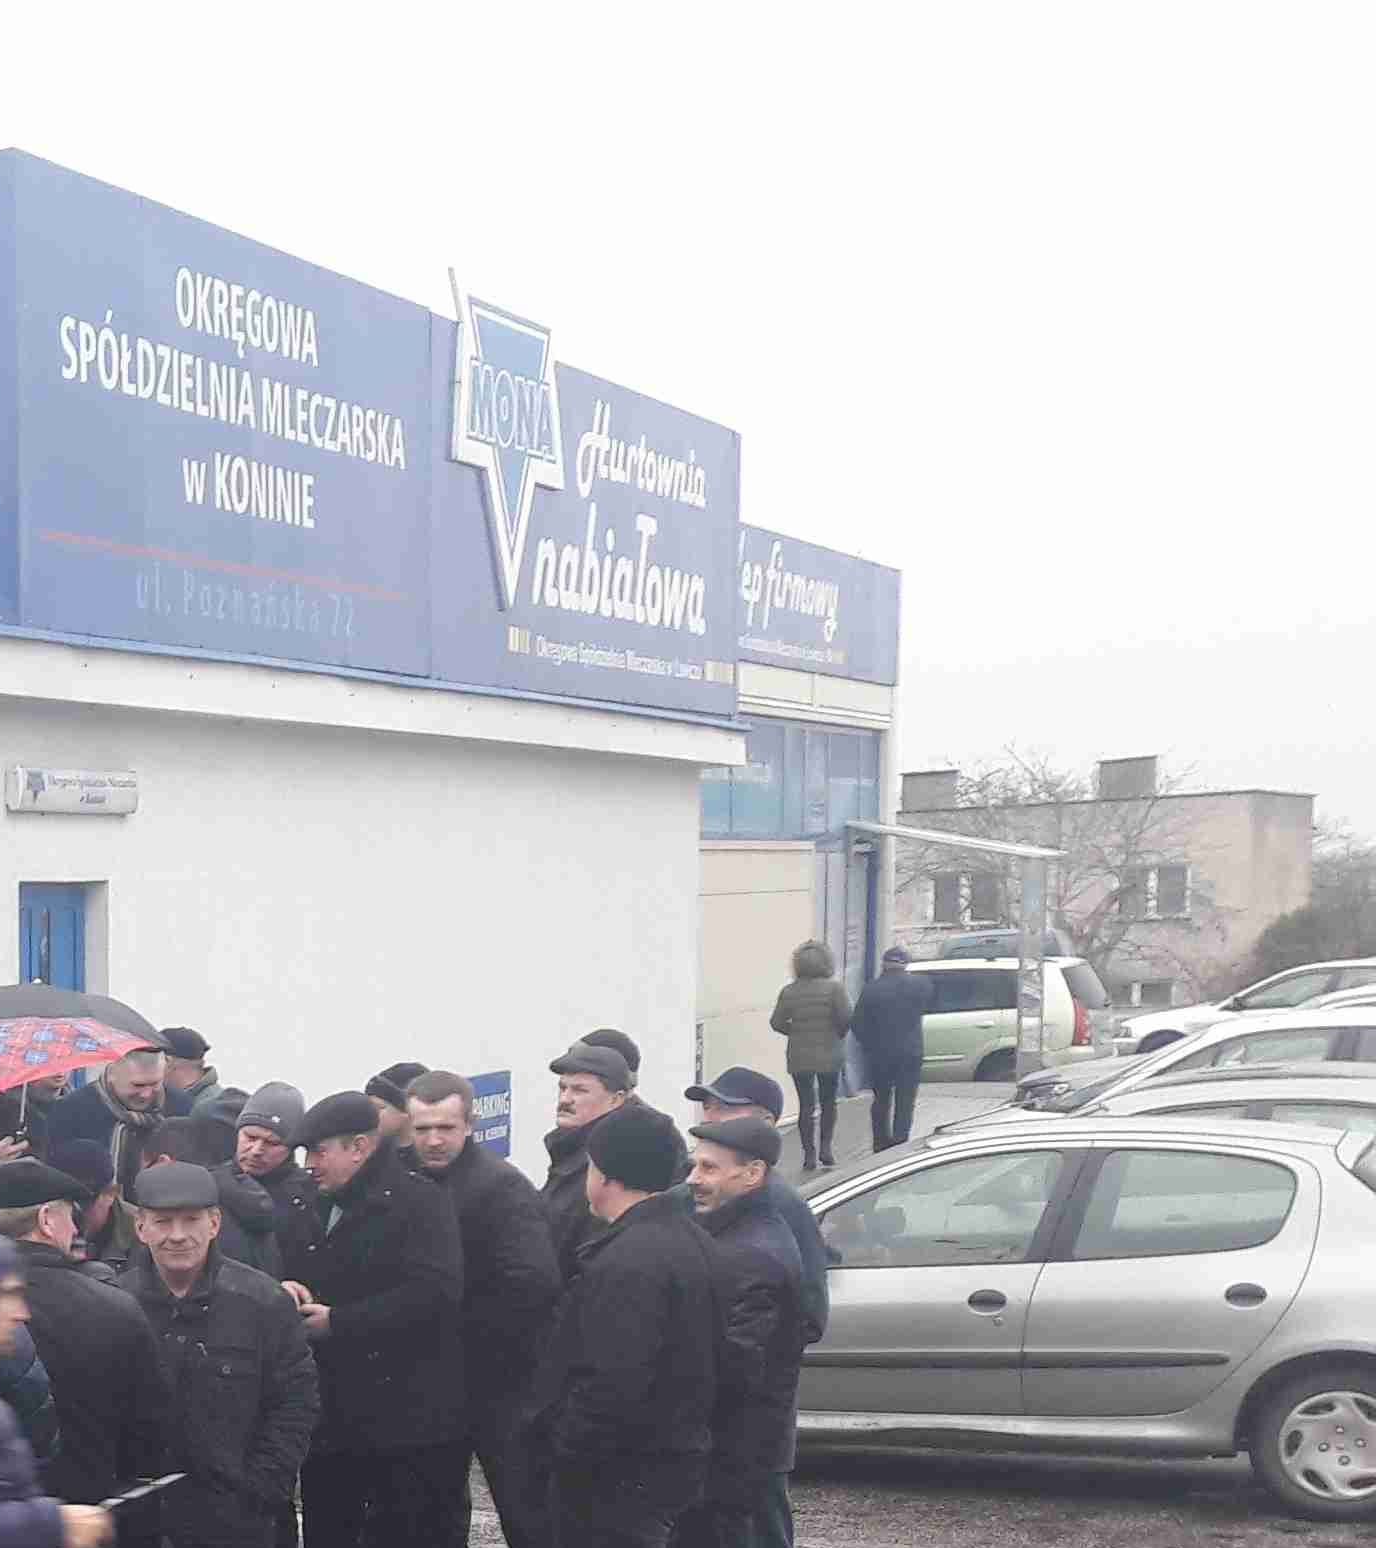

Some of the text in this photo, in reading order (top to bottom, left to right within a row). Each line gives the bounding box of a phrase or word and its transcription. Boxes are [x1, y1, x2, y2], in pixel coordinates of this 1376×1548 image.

[174, 267, 319, 368] OKRĘGOWA
[59, 309, 407, 470] SPÓŁDZIELNIA MLECZARSKA
[182, 452, 316, 528] w KONINIE
[576, 399, 706, 508] Hurtownia
